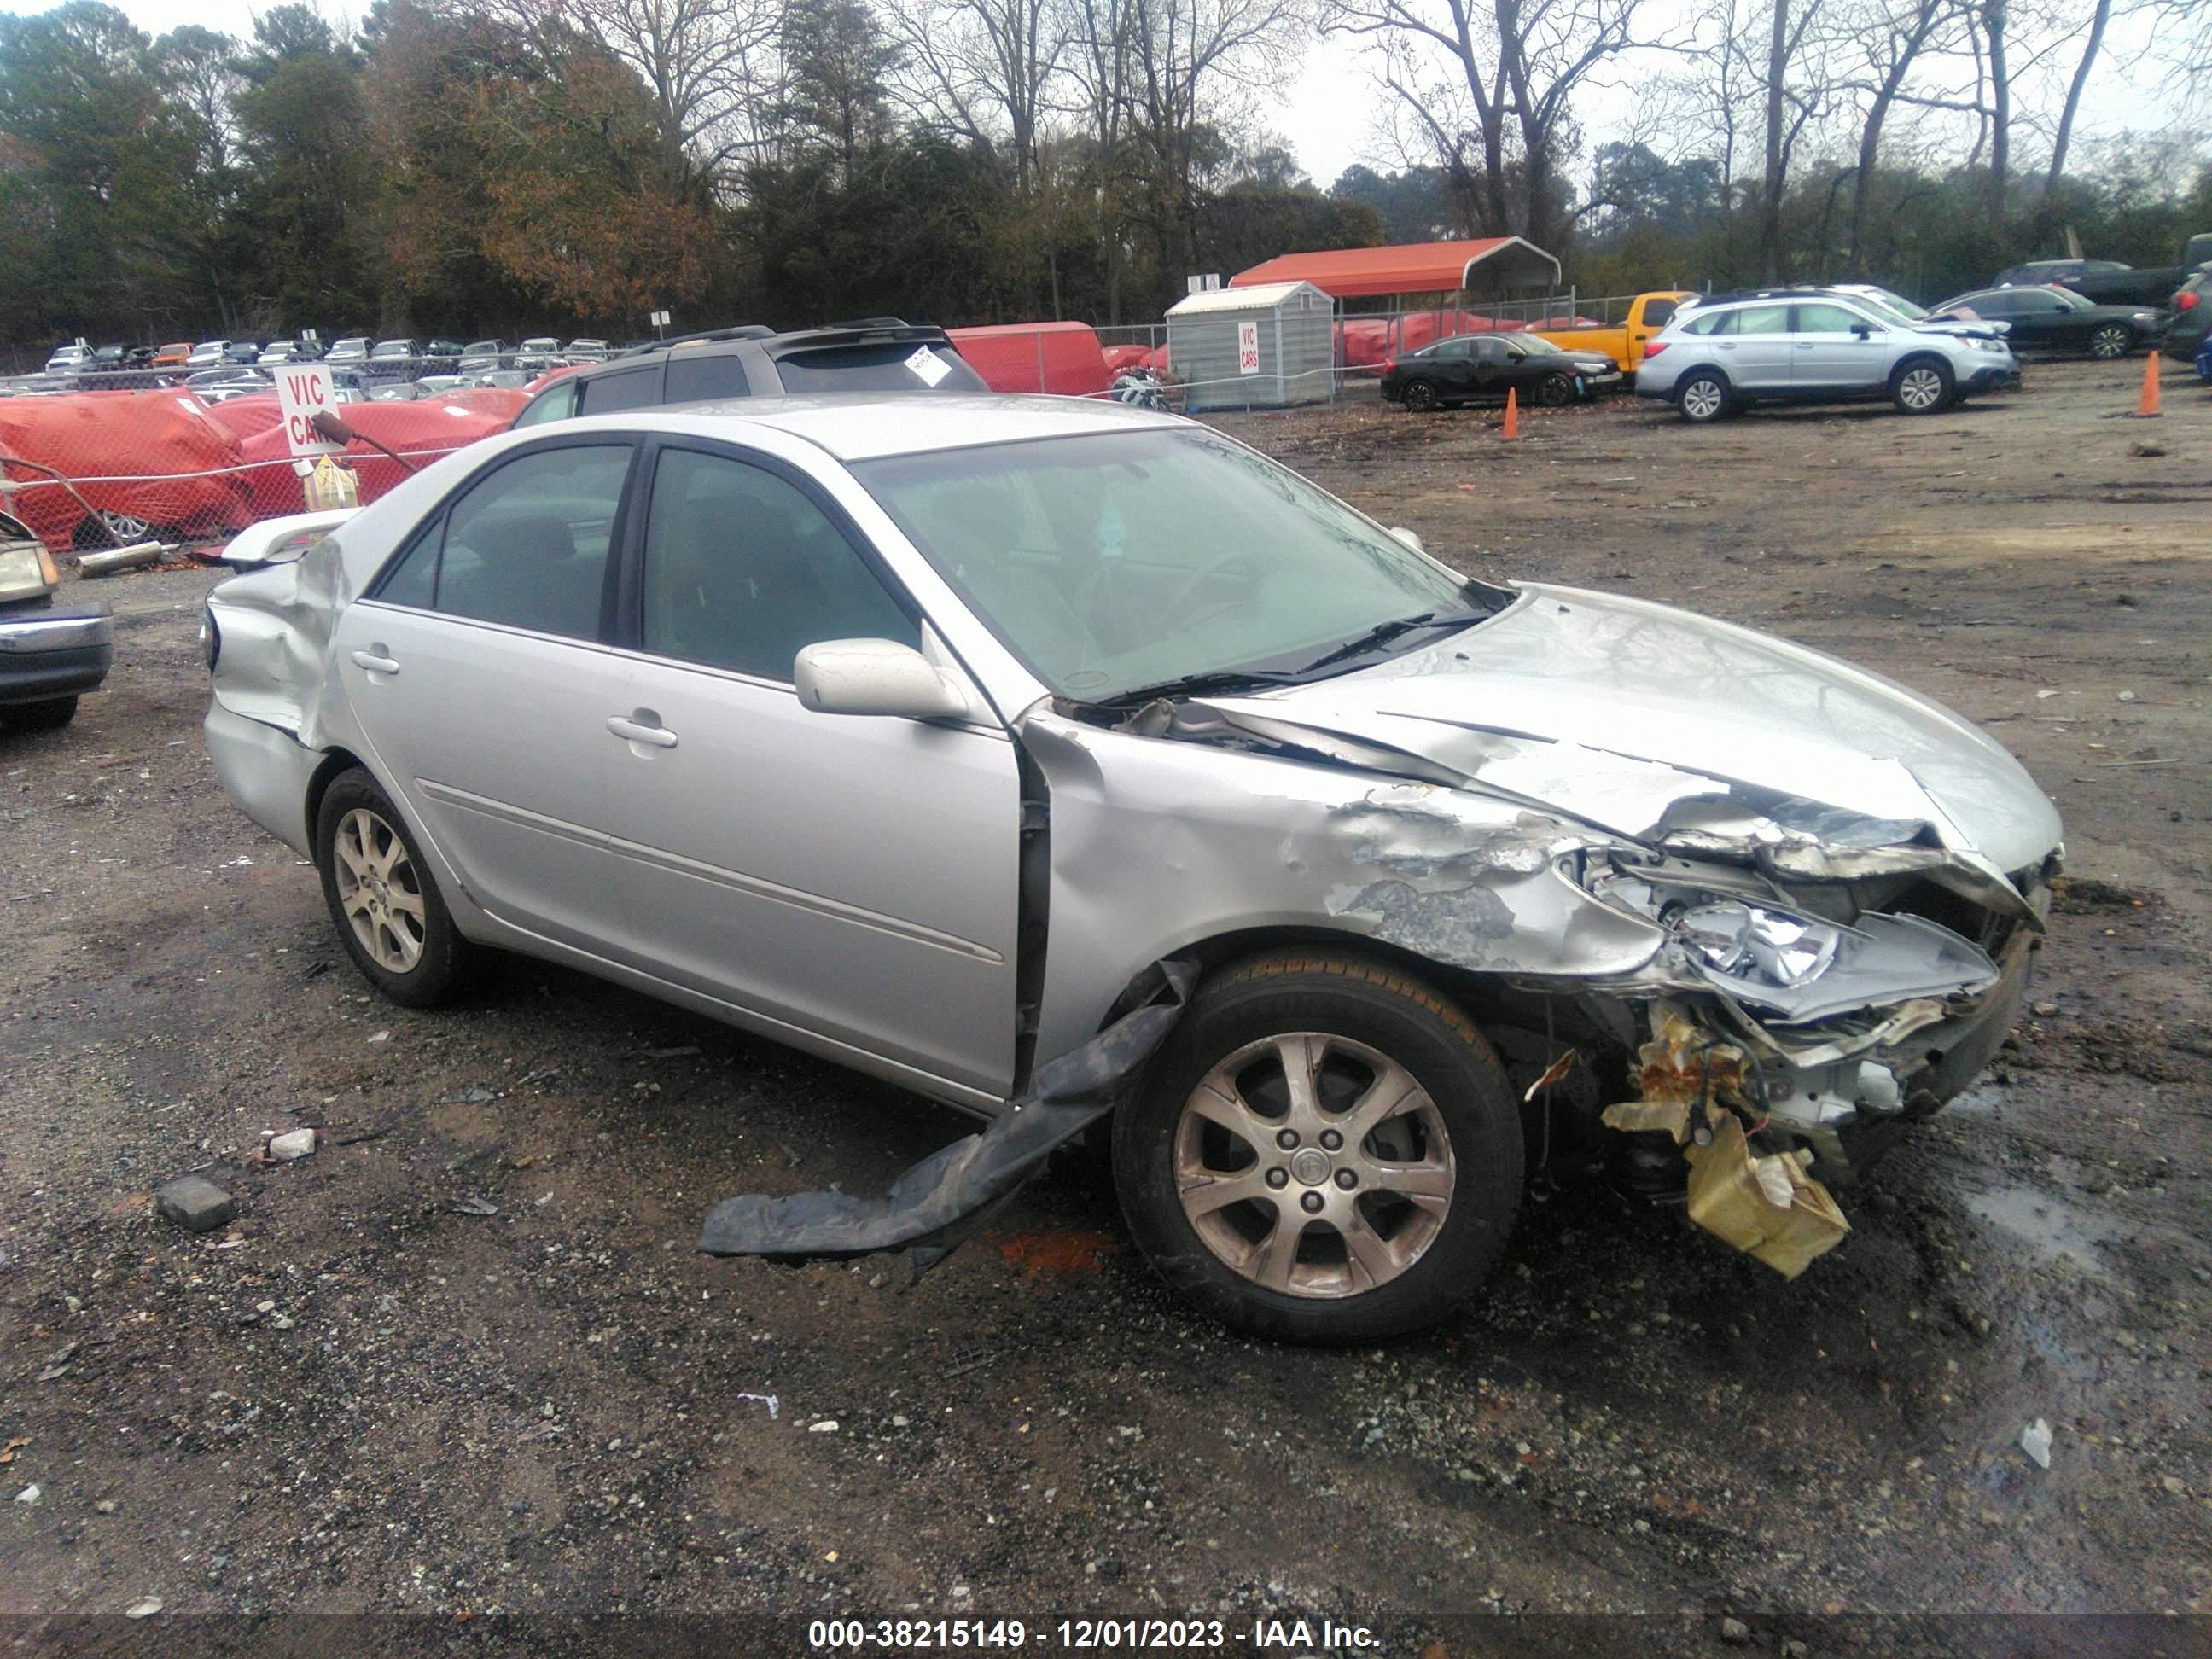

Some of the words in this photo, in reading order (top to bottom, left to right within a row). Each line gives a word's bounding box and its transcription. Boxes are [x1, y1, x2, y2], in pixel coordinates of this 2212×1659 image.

[1243, 328, 1254, 345] VIC
[1242, 350, 1257, 369] CARS
[287, 374, 323, 405] VIC
[290, 415, 332, 445] CA
